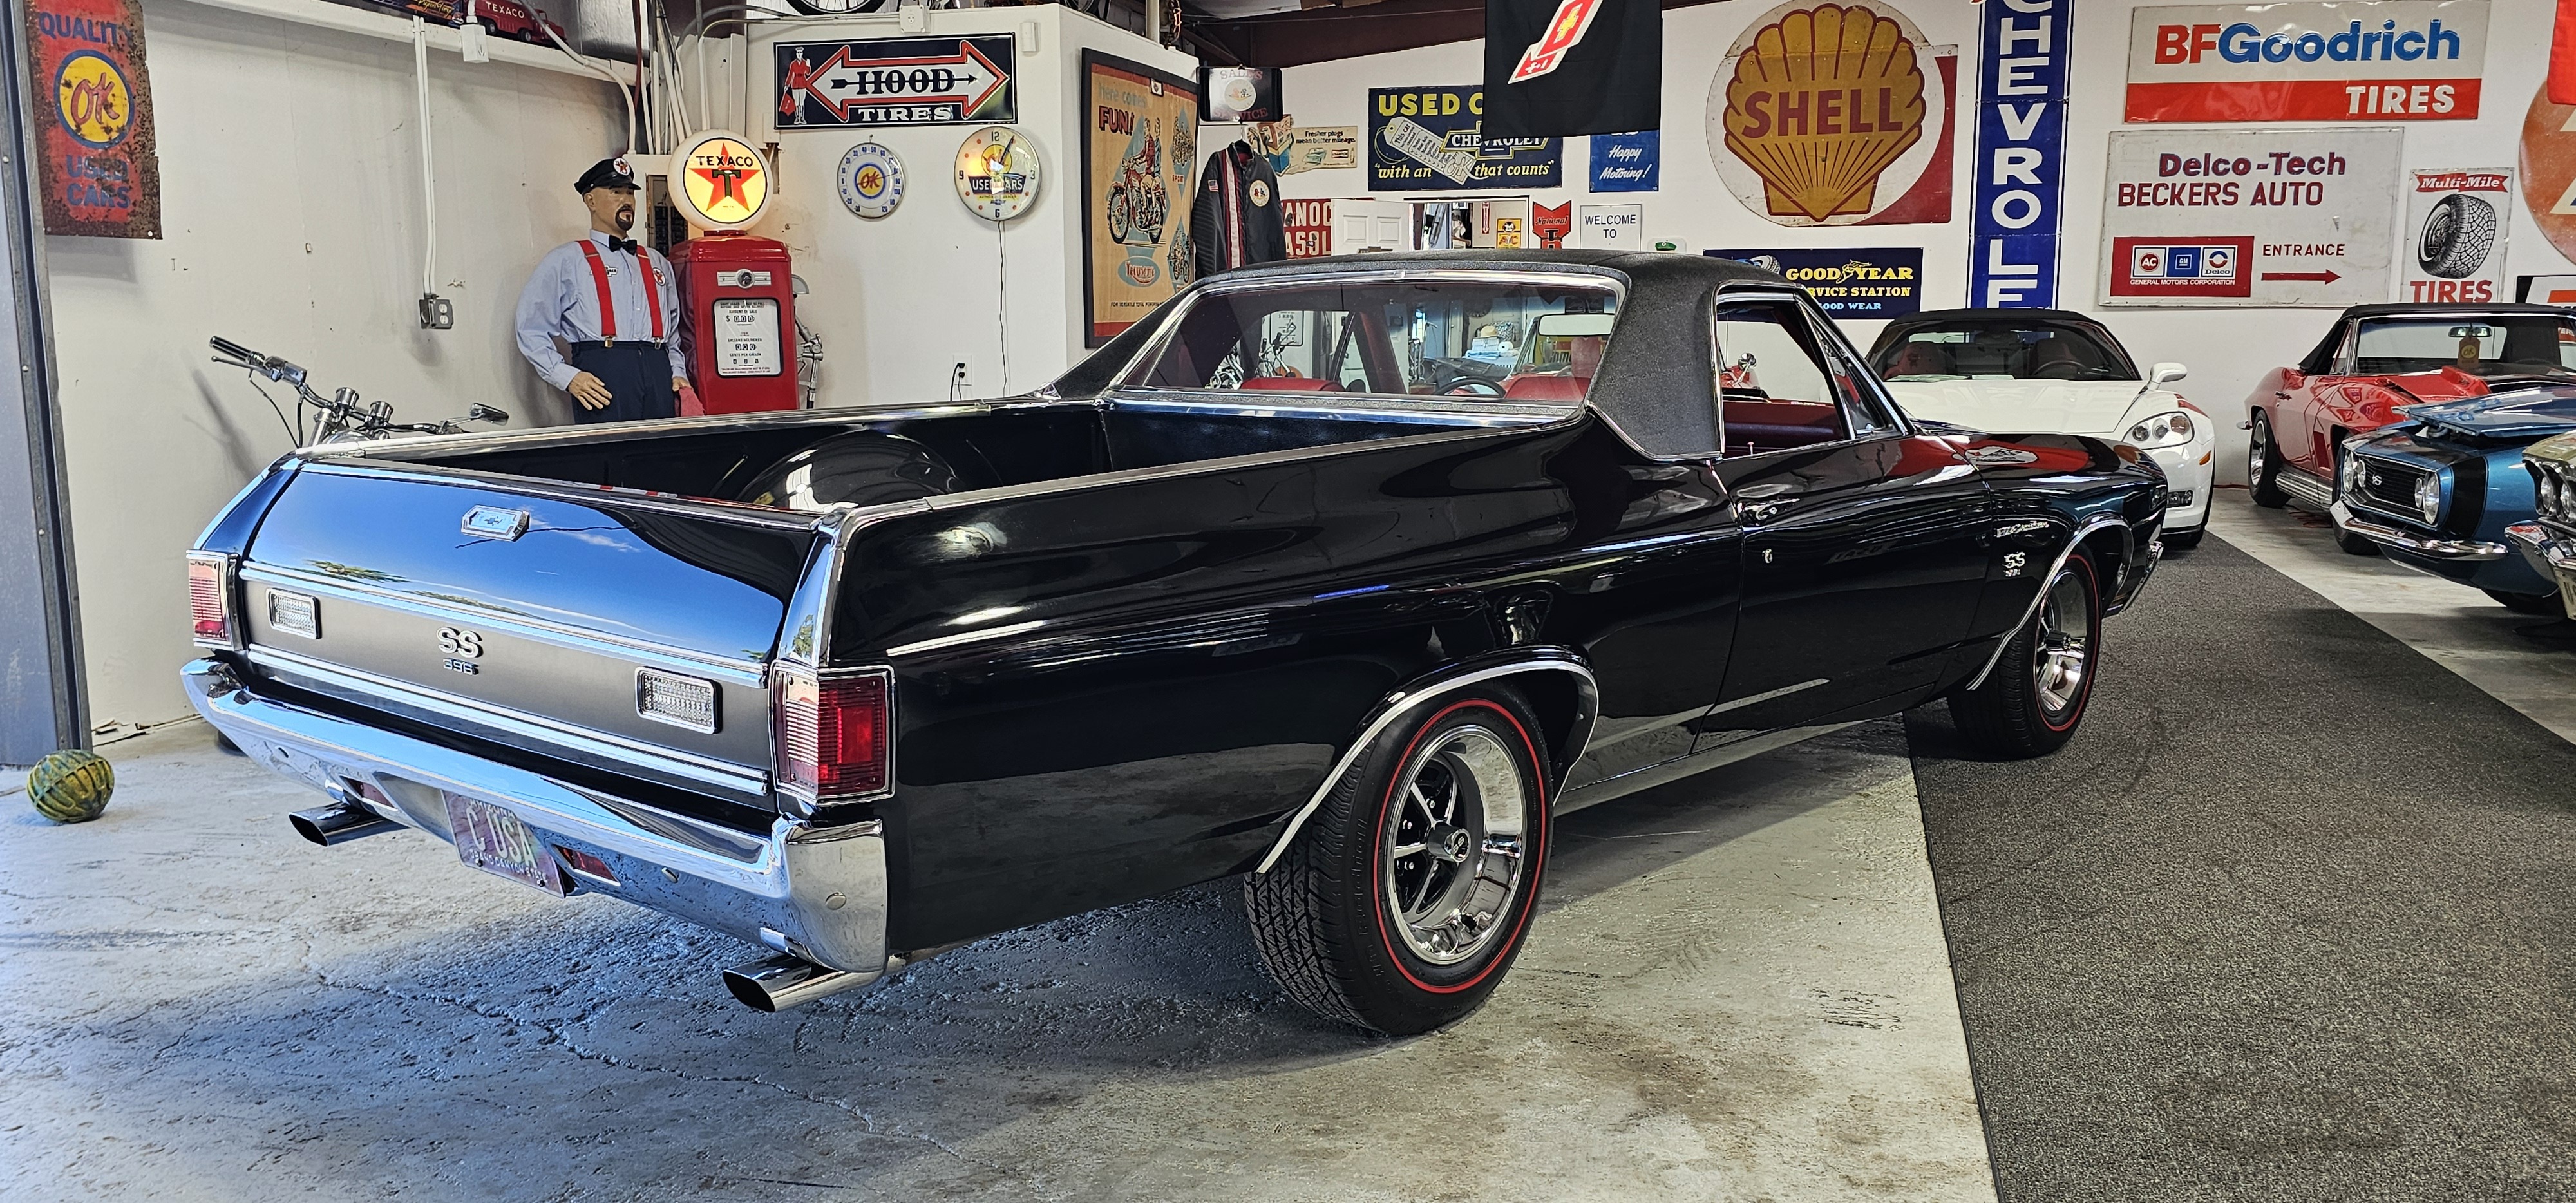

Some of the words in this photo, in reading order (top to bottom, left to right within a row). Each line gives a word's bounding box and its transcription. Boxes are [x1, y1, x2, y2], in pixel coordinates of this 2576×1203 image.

[486, 1, 525, 19] TEXACO
[2154, 18, 2461, 64] BFGoodrich
[857, 68, 954, 95] HOOD
[1220, 68, 1264, 81] SALES
[71, 71, 120, 126] OK
[1099, 83, 1119, 100] here
[2345, 84, 2455, 114] TIRES
[1379, 93, 1460, 116] USED
[1741, 88, 1903, 138] SHELL
[858, 106, 953, 121] TIRES
[1099, 105, 1135, 136] FUN!
[1214, 108, 1268, 120] SERVICE
[991, 131, 999, 141] 12
[696, 156, 753, 167] TEXACO
[1609, 145, 1642, 162] Happy
[1986, 0, 2052, 308] HEVROLE
[66, 155, 128, 181] USED
[959, 170, 964, 180] 9
[1030, 170, 1035, 180] 3
[1414, 167, 1432, 178] an
[1475, 162, 1503, 176] that
[1599, 164, 1653, 182] Motoring!
[860, 171, 880, 189] OK
[1004, 179, 1023, 191] ARS
[1172, 175, 1184, 183] SPORT
[2420, 177, 2500, 189] Multi-Mile
[66, 183, 131, 209] CARS
[2117, 182, 2240, 207] BECKERS
[2250, 182, 2324, 206] AUTO
[995, 209, 1000, 218] 6
[1535, 216, 1569, 225] National
[1585, 214, 1636, 225] WELCOME
[1603, 229, 1617, 238] TO
[2262, 243, 2345, 256] ENTRANCE
[2141, 258, 2157, 267] AC
[1808, 287, 1848, 296] RVICE
[1851, 287, 1911, 296] STATION
[2410, 279, 2492, 303] TIRES
[2003, 551, 2025, 569] SS
[437, 627, 480, 658] SS
[443, 658, 475, 676] 396
[466, 805, 486, 851] C
[486, 811, 538, 869] USA
[496, 857, 525, 875] CANYON
[525, 866, 548, 883] STATE
